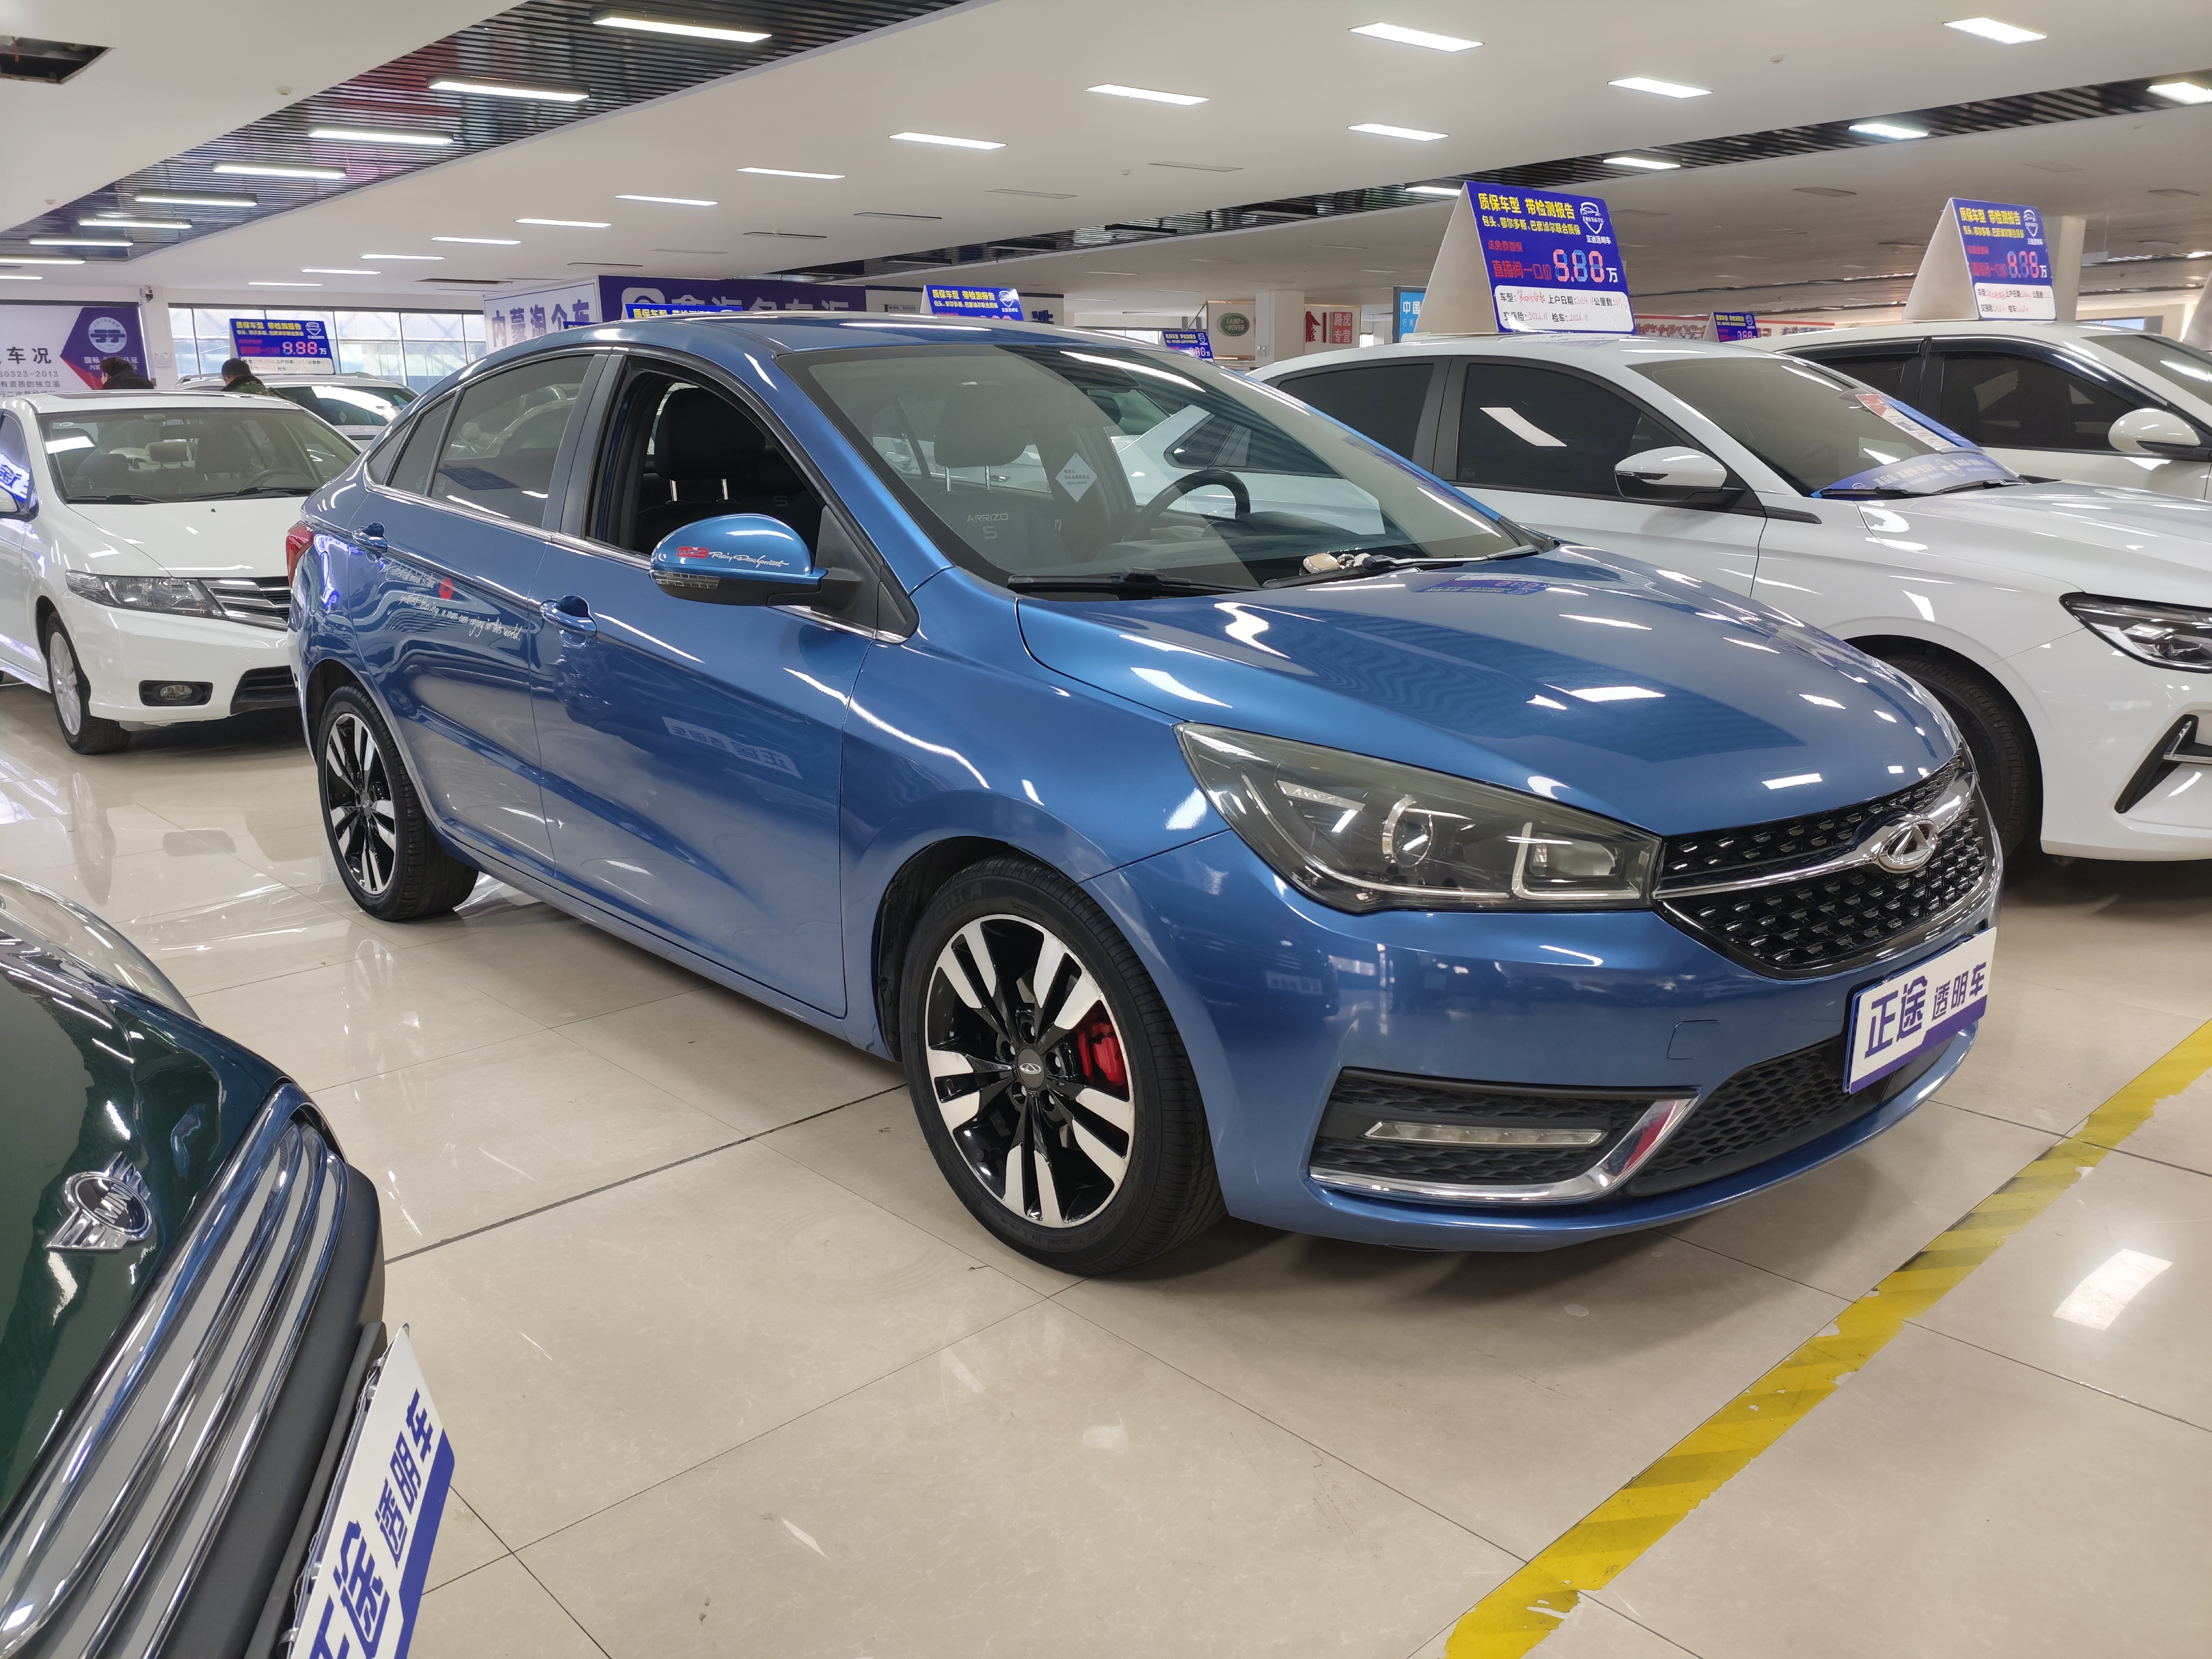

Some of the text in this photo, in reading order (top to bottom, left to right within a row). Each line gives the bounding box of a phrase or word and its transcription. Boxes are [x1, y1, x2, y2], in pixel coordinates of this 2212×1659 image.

[1478, 193, 1575, 220] 质保车型 带检测报告
[1334, 313, 1352, 327] 路虎
[1333, 329, 1351, 343] 专营
[967, 512, 1009, 523] ARRIZO
[982, 525, 997, 539] 5
[93, 1183, 133, 1224] MINI
